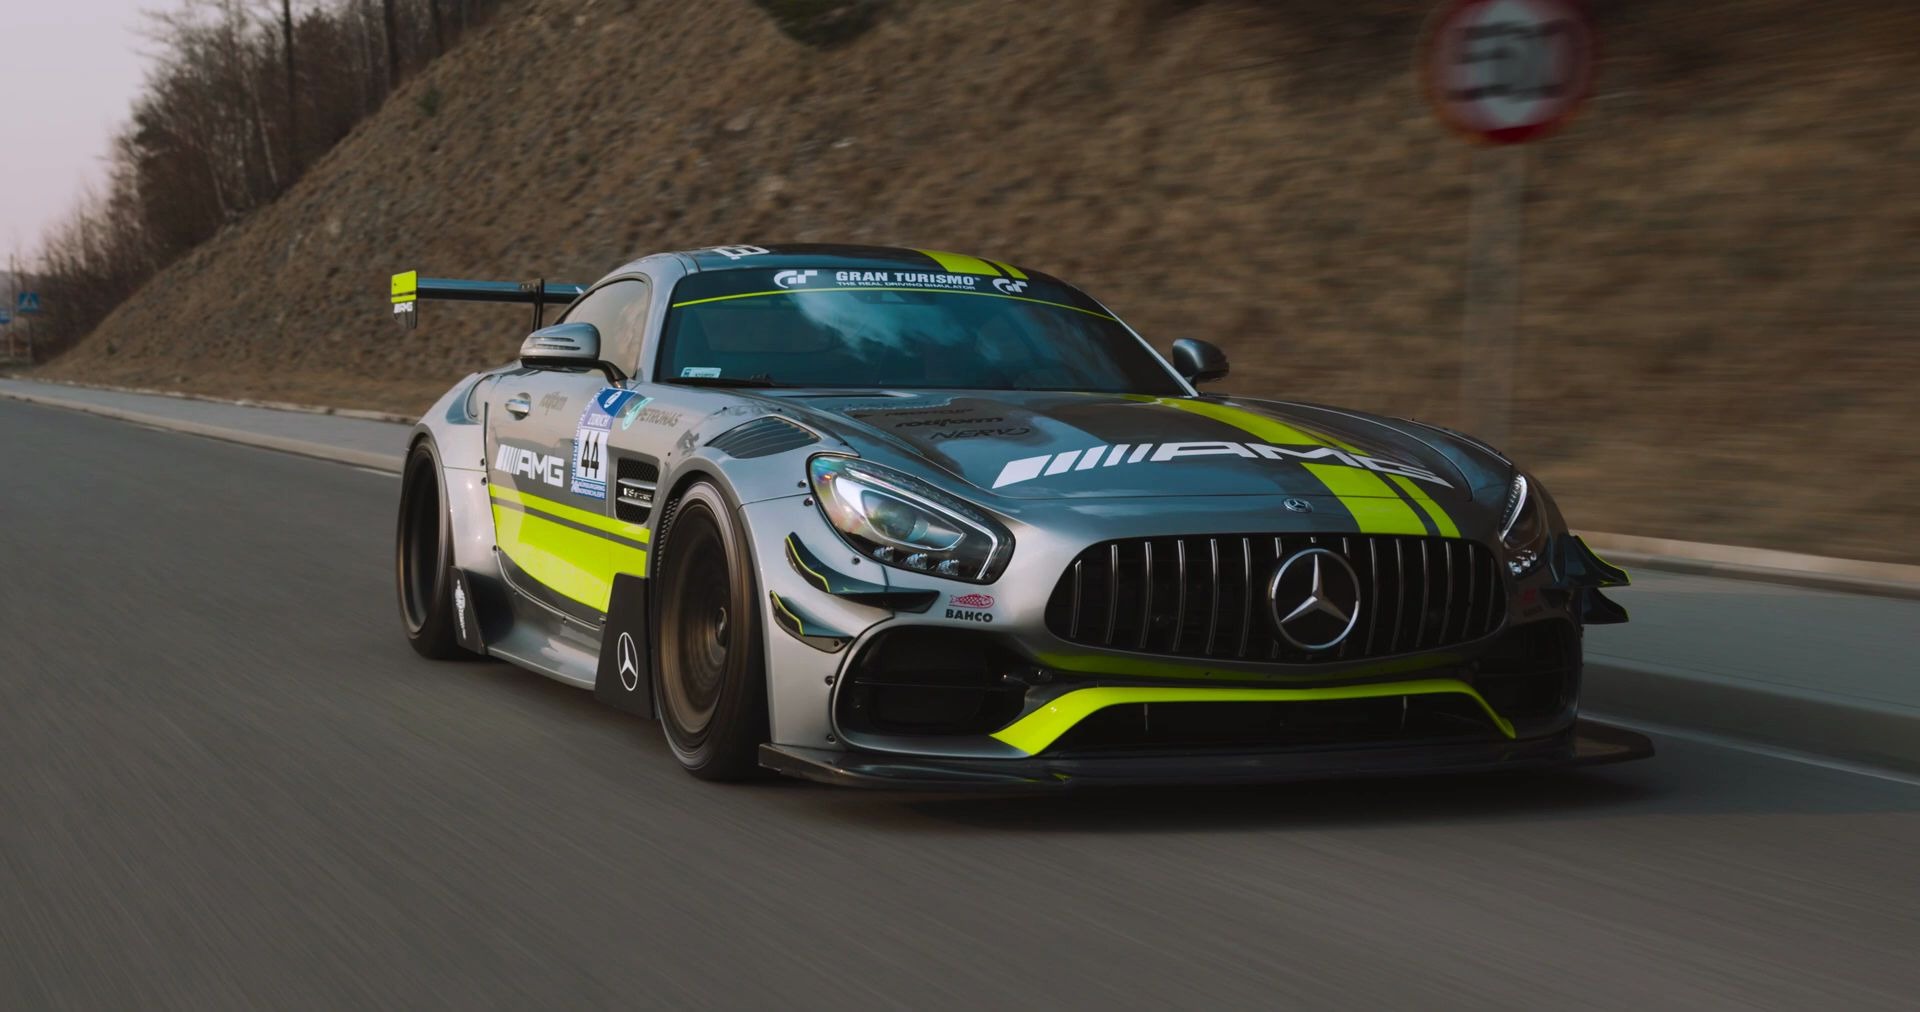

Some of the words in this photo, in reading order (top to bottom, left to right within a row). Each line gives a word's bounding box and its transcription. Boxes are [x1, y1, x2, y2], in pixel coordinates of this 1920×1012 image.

[835, 271, 888, 282] GRAN
[894, 272, 975, 285] TURISMO
[514, 455, 564, 488] AMG
[581, 431, 599, 479] 44
[1149, 442, 1454, 488] AMG
[945, 608, 993, 623] BAHCO
